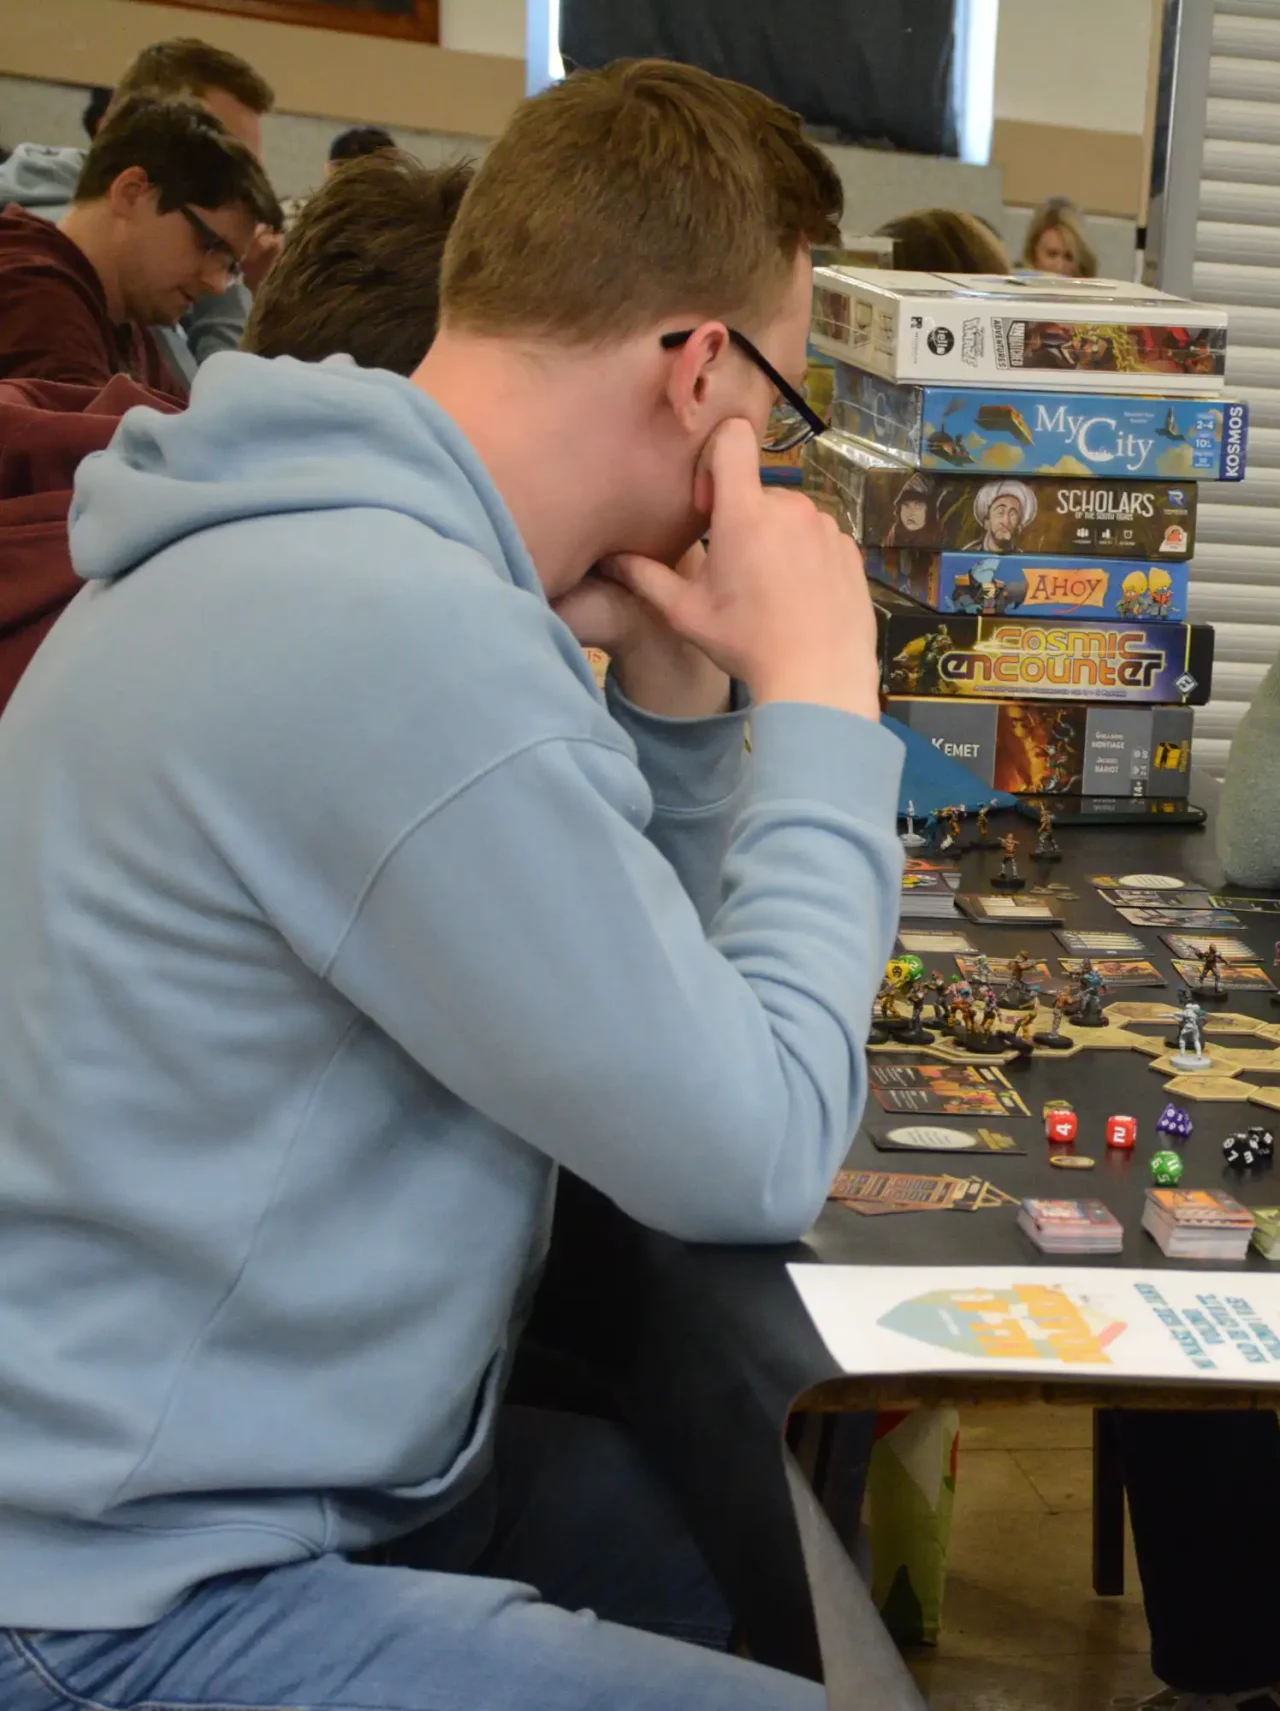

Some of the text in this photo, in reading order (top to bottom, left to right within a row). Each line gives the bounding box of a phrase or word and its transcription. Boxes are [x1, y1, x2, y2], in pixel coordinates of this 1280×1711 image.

[993, 319, 1007, 368] ADVENTURES
[1009, 321, 1026, 367] UNMATCHED
[1035, 404, 1155, 471] My City
[1225, 406, 1244, 477] KOSMOS
[1056, 489, 1155, 517] SCHOLARS
[1029, 574, 1103, 613] AHOY
[931, 737, 980, 758] KEMET
[1055, 1122, 1073, 1137] 4
